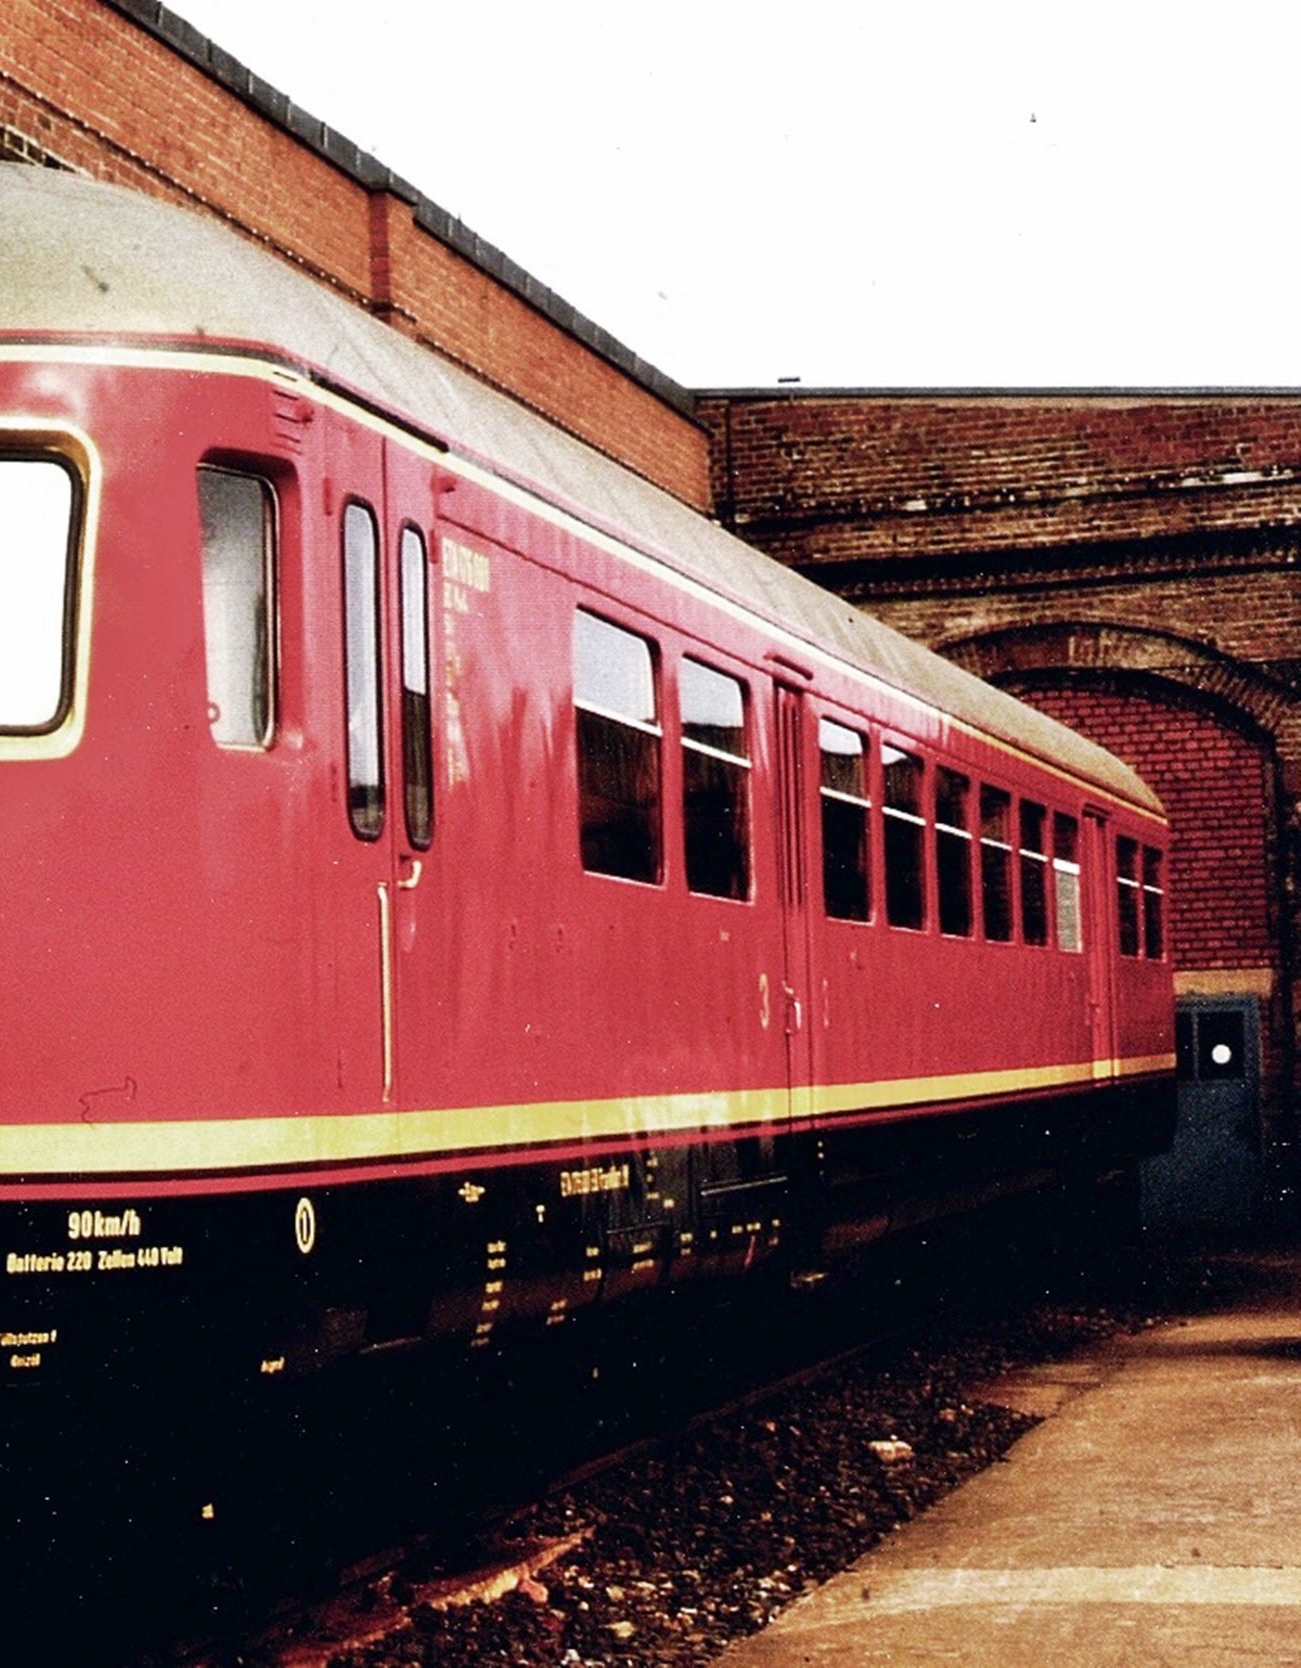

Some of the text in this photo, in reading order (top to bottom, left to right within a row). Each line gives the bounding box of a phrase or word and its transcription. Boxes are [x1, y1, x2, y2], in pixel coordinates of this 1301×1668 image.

[67, 1209, 141, 1240] 90 km/h
[6, 1252, 65, 1274] Batterie
[66, 1250, 92, 1272] 220
